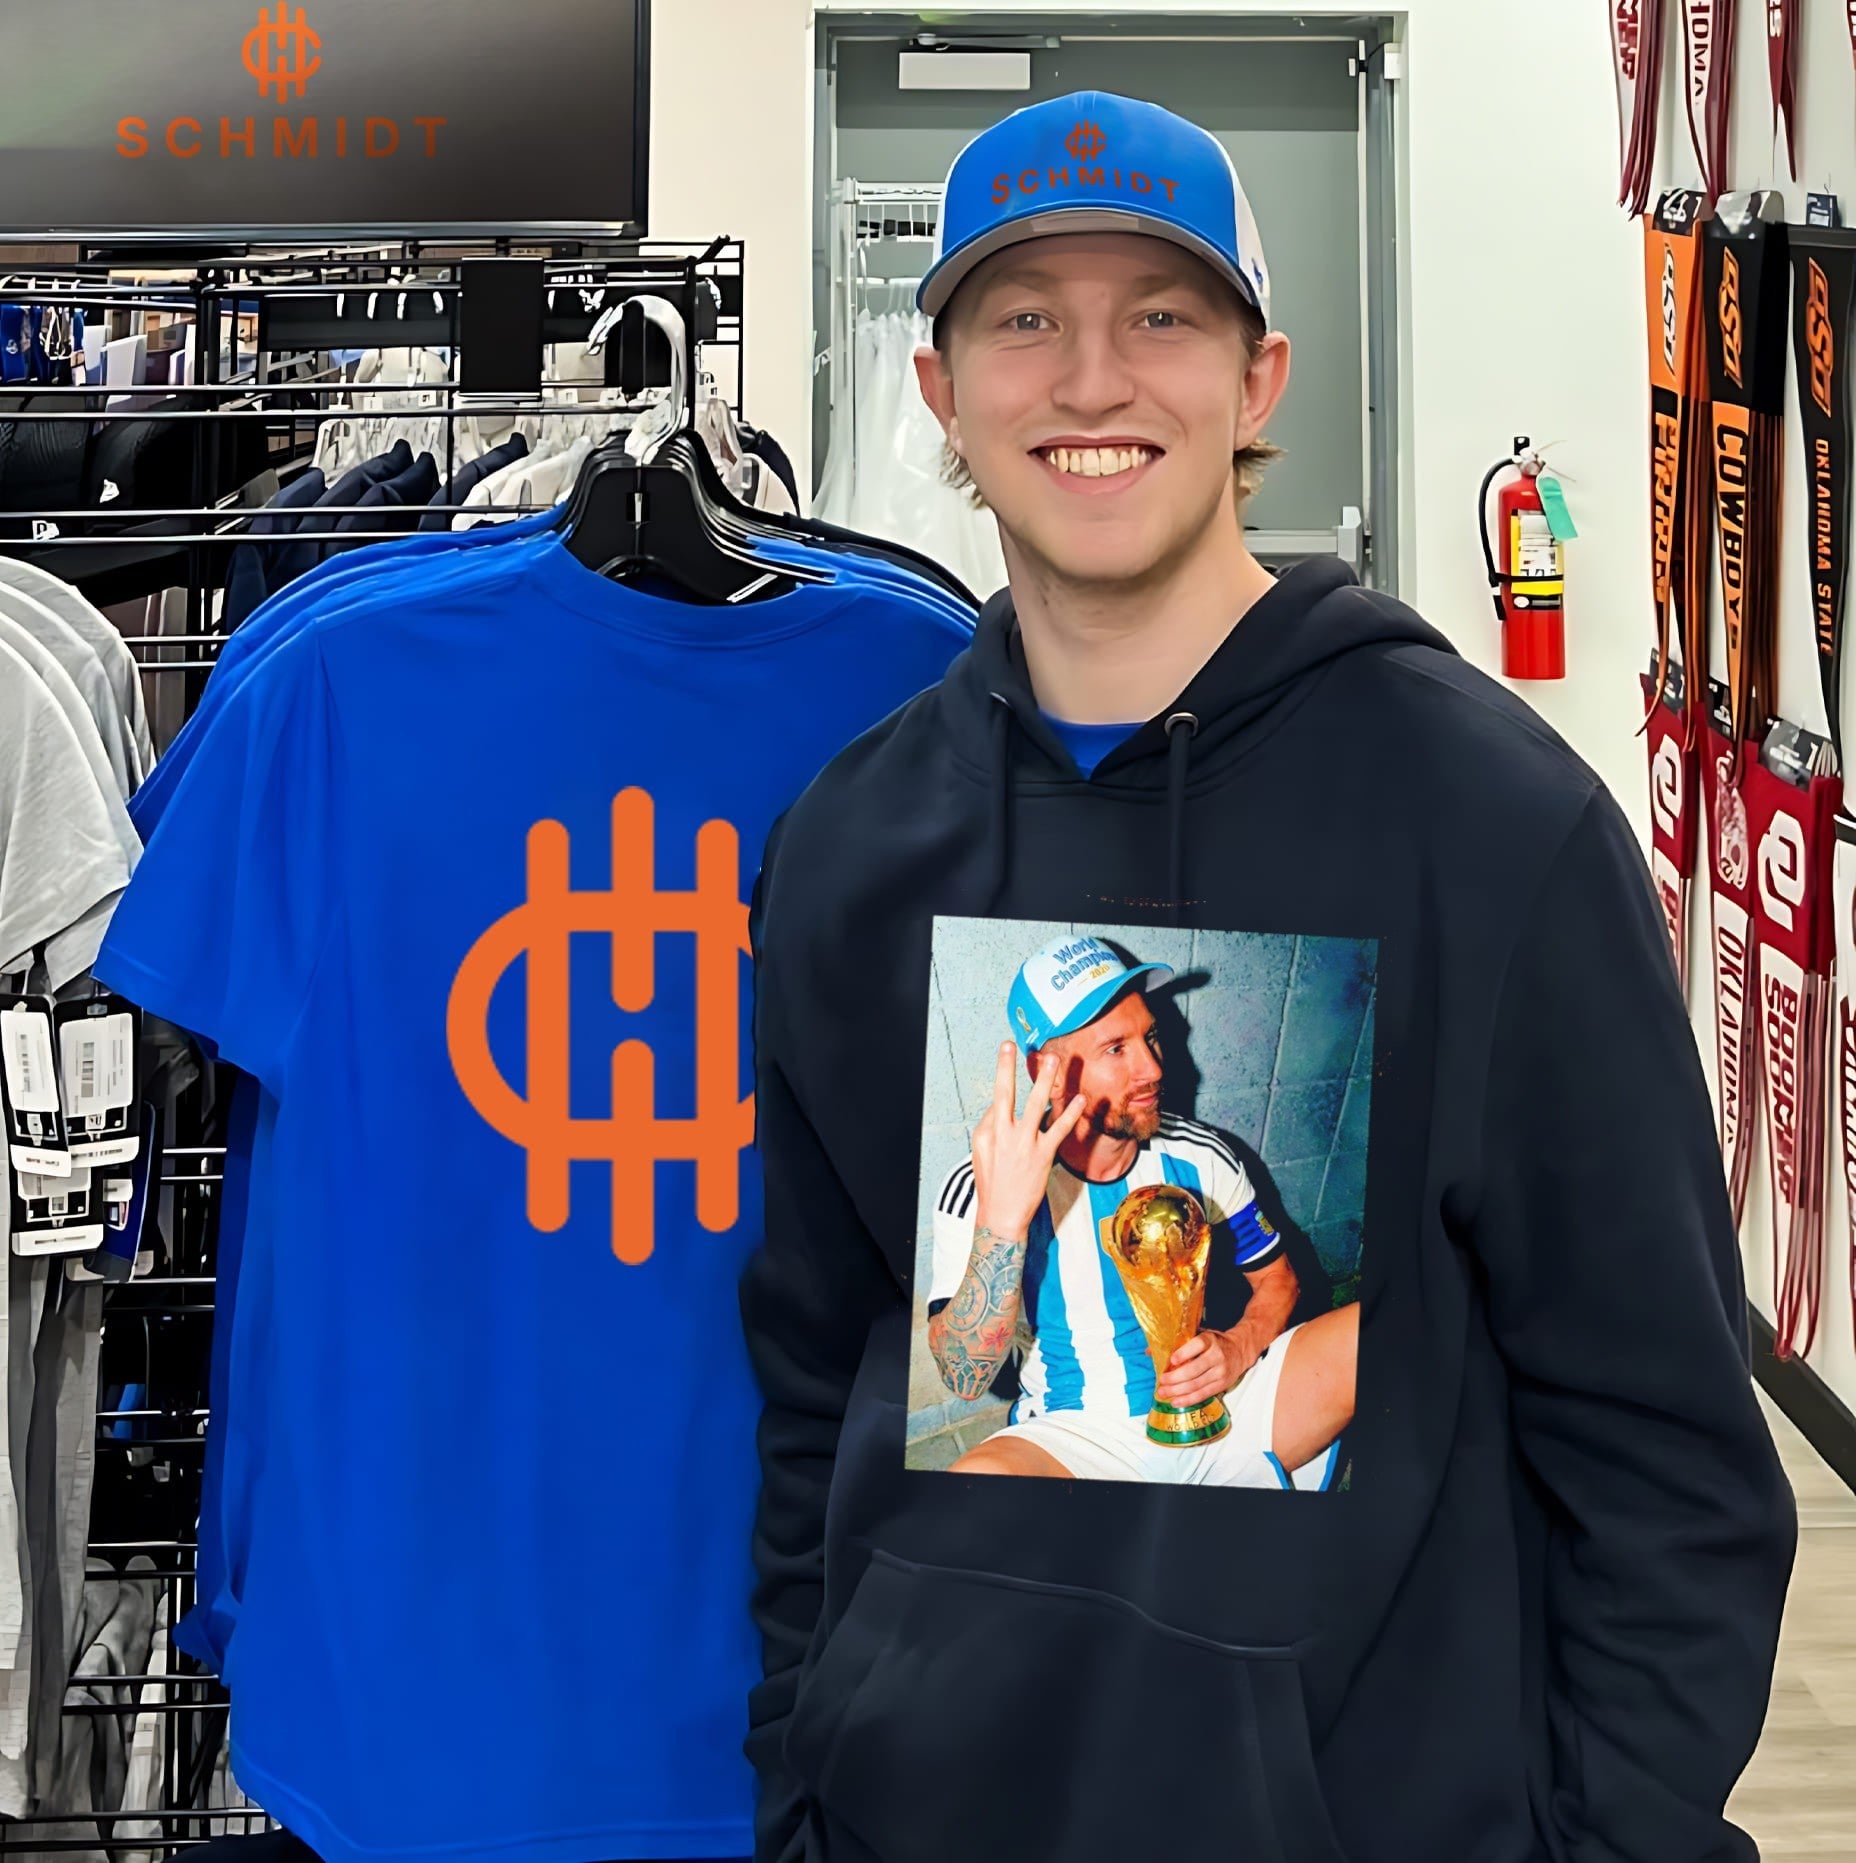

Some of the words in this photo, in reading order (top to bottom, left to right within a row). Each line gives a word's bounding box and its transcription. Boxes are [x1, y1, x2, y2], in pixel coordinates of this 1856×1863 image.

[116, 116, 447, 159] SCHMIDT
[991, 167, 1179, 204] SCHMIDT
[1815, 438, 1832, 570] OKLAHOMA
[1053, 936, 1099, 965] World
[1718, 925, 1745, 1144] OKLAHOMA
